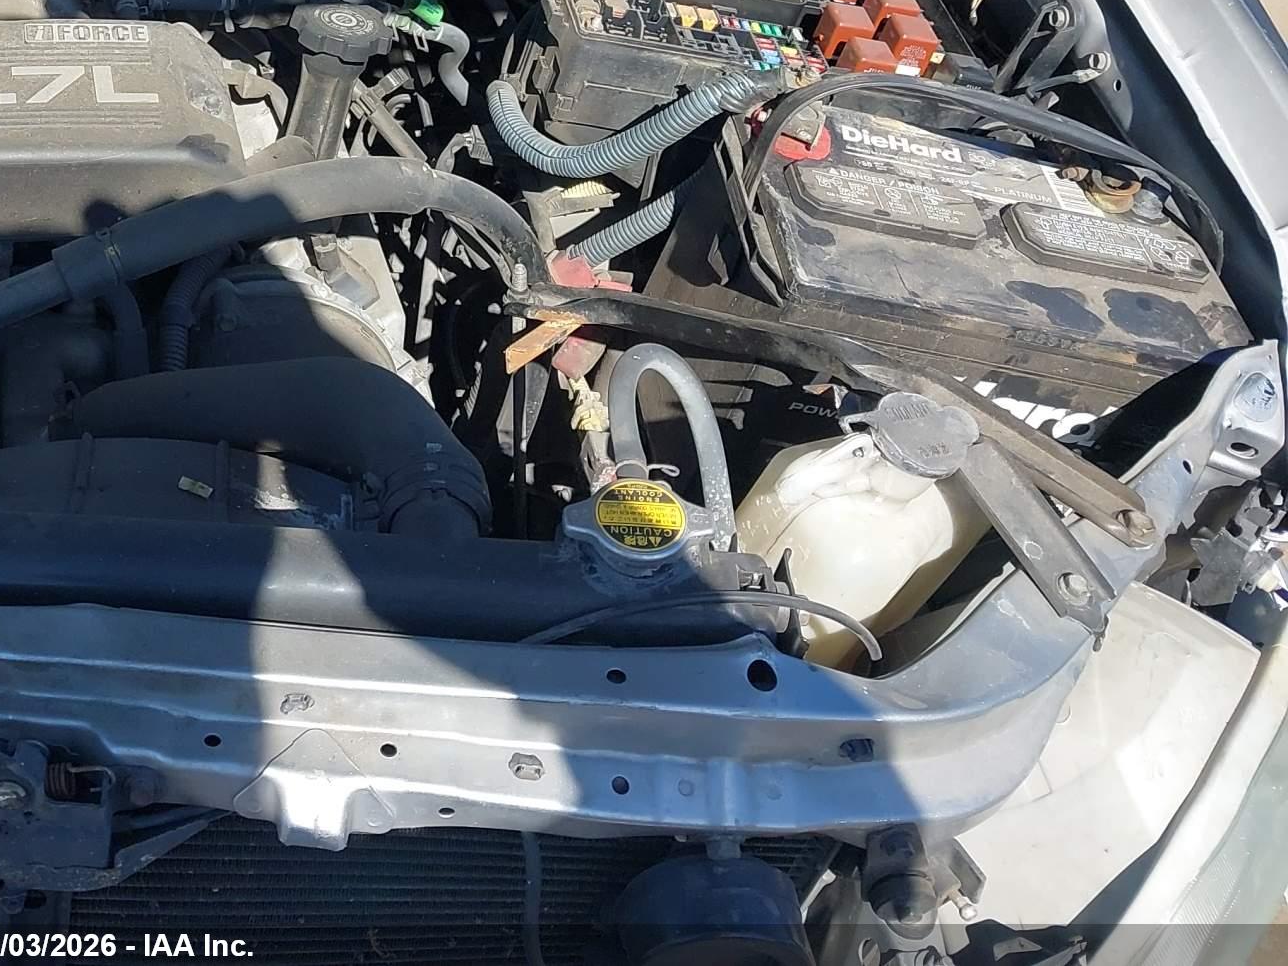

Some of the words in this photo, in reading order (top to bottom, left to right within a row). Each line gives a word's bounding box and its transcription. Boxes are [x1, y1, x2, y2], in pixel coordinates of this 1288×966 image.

[841, 124, 963, 164] DieHard
[838, 170, 886, 185] DANGER
[897, 180, 940, 196] POISON
[994, 186, 1053, 204] PLATINUM
[788, 401, 839, 420] POW
[614, 489, 663, 498] COOLANT
[617, 495, 660, 503] ENGINE
[611, 525, 672, 538] CAUTION
